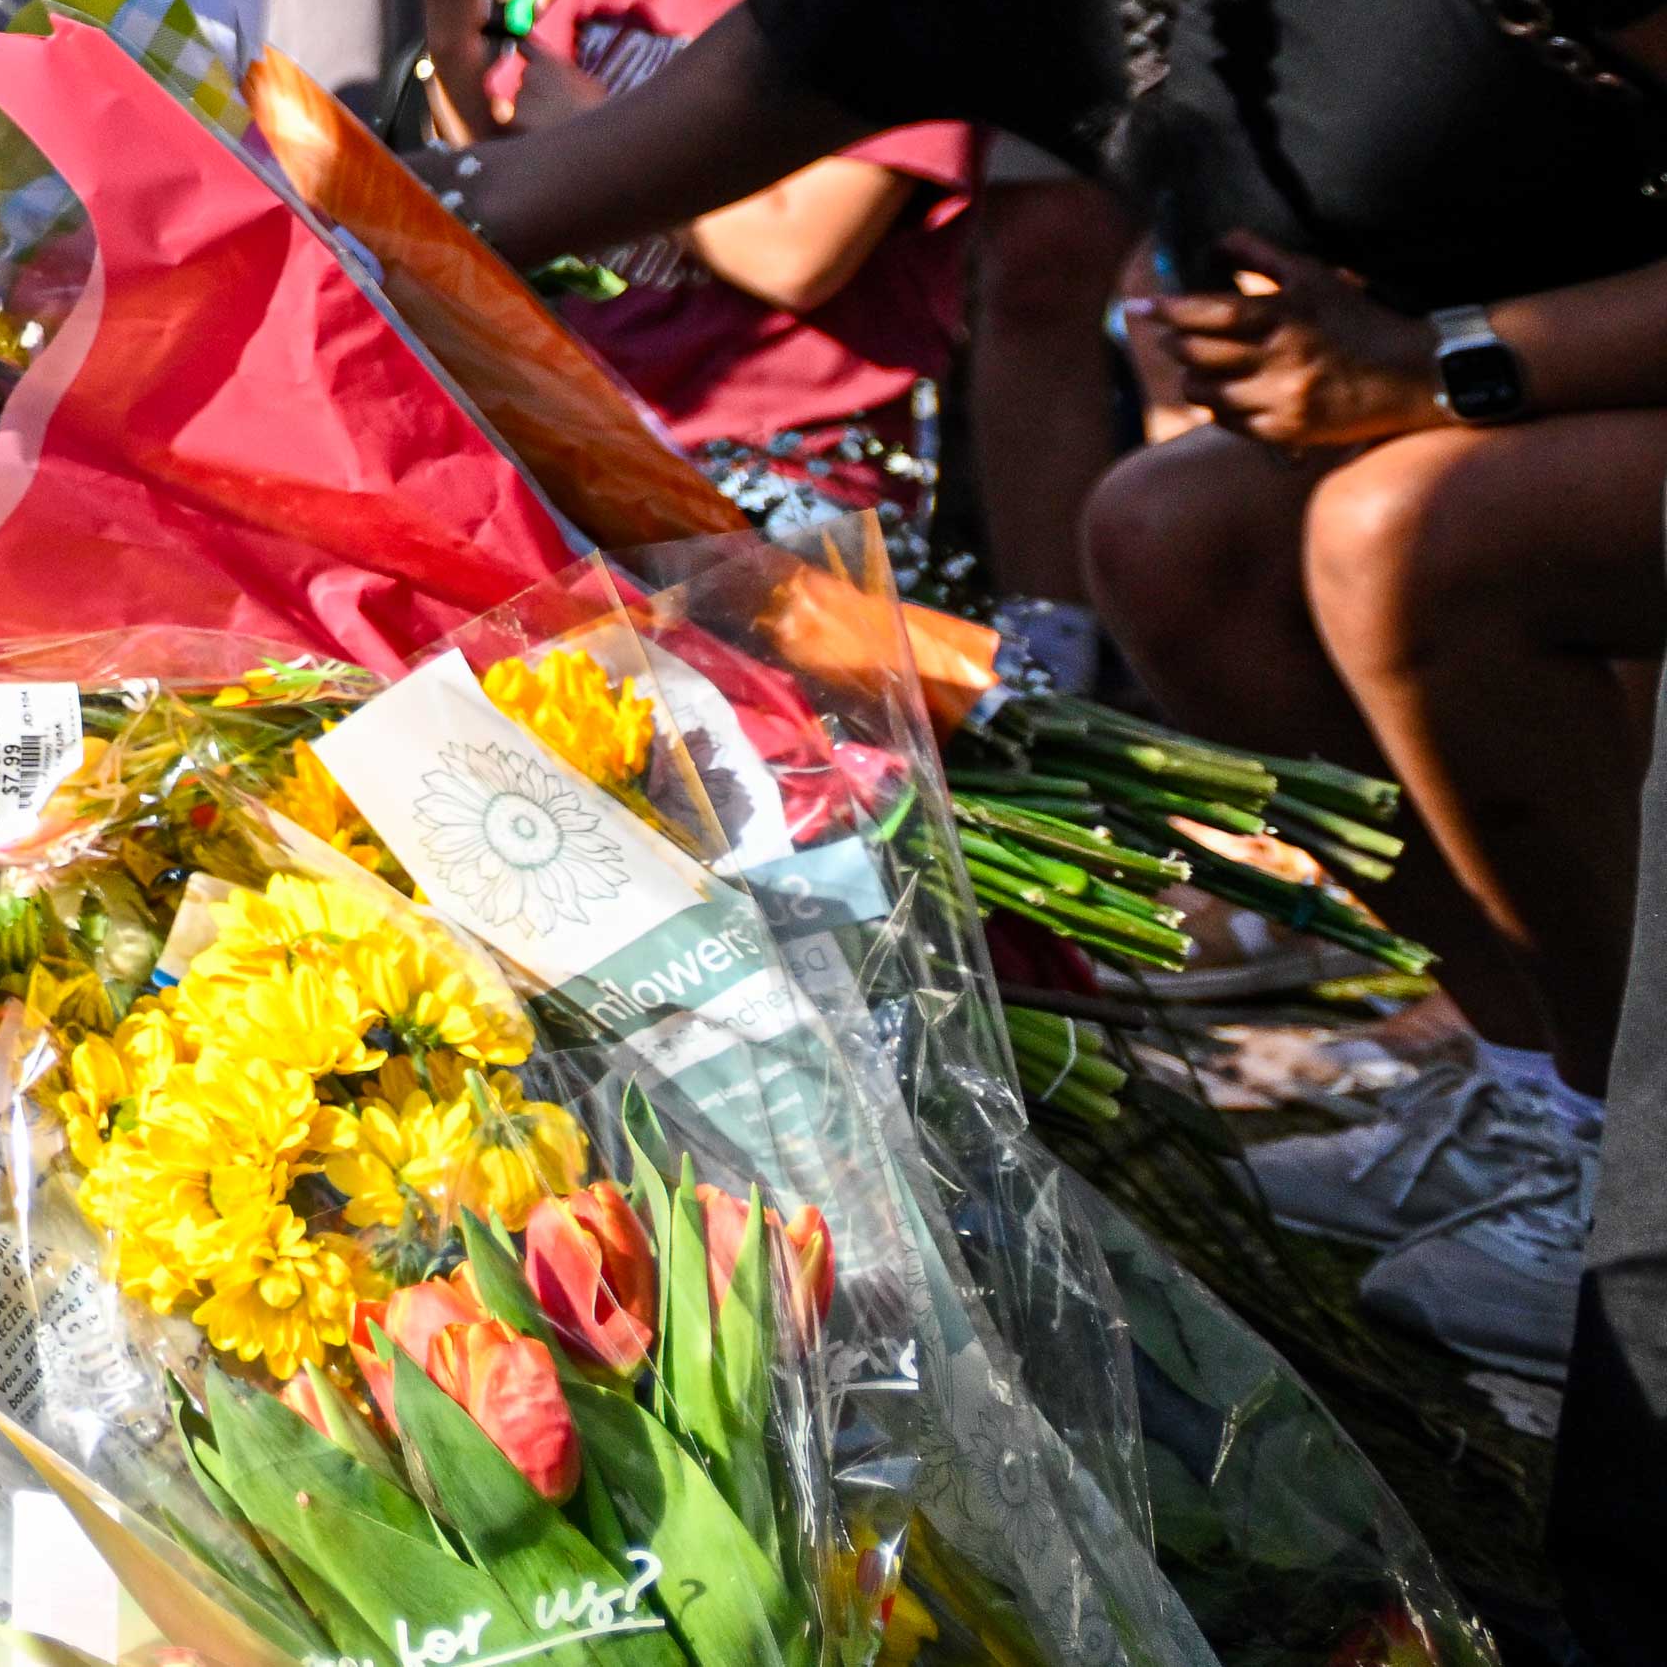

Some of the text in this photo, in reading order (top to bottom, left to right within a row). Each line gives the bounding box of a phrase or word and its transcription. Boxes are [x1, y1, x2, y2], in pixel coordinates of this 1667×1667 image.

[2, 744, 22, 796] $7.99
[0, 1365, 22, 1394] vous
[8, 1367, 45, 1411] bouque
